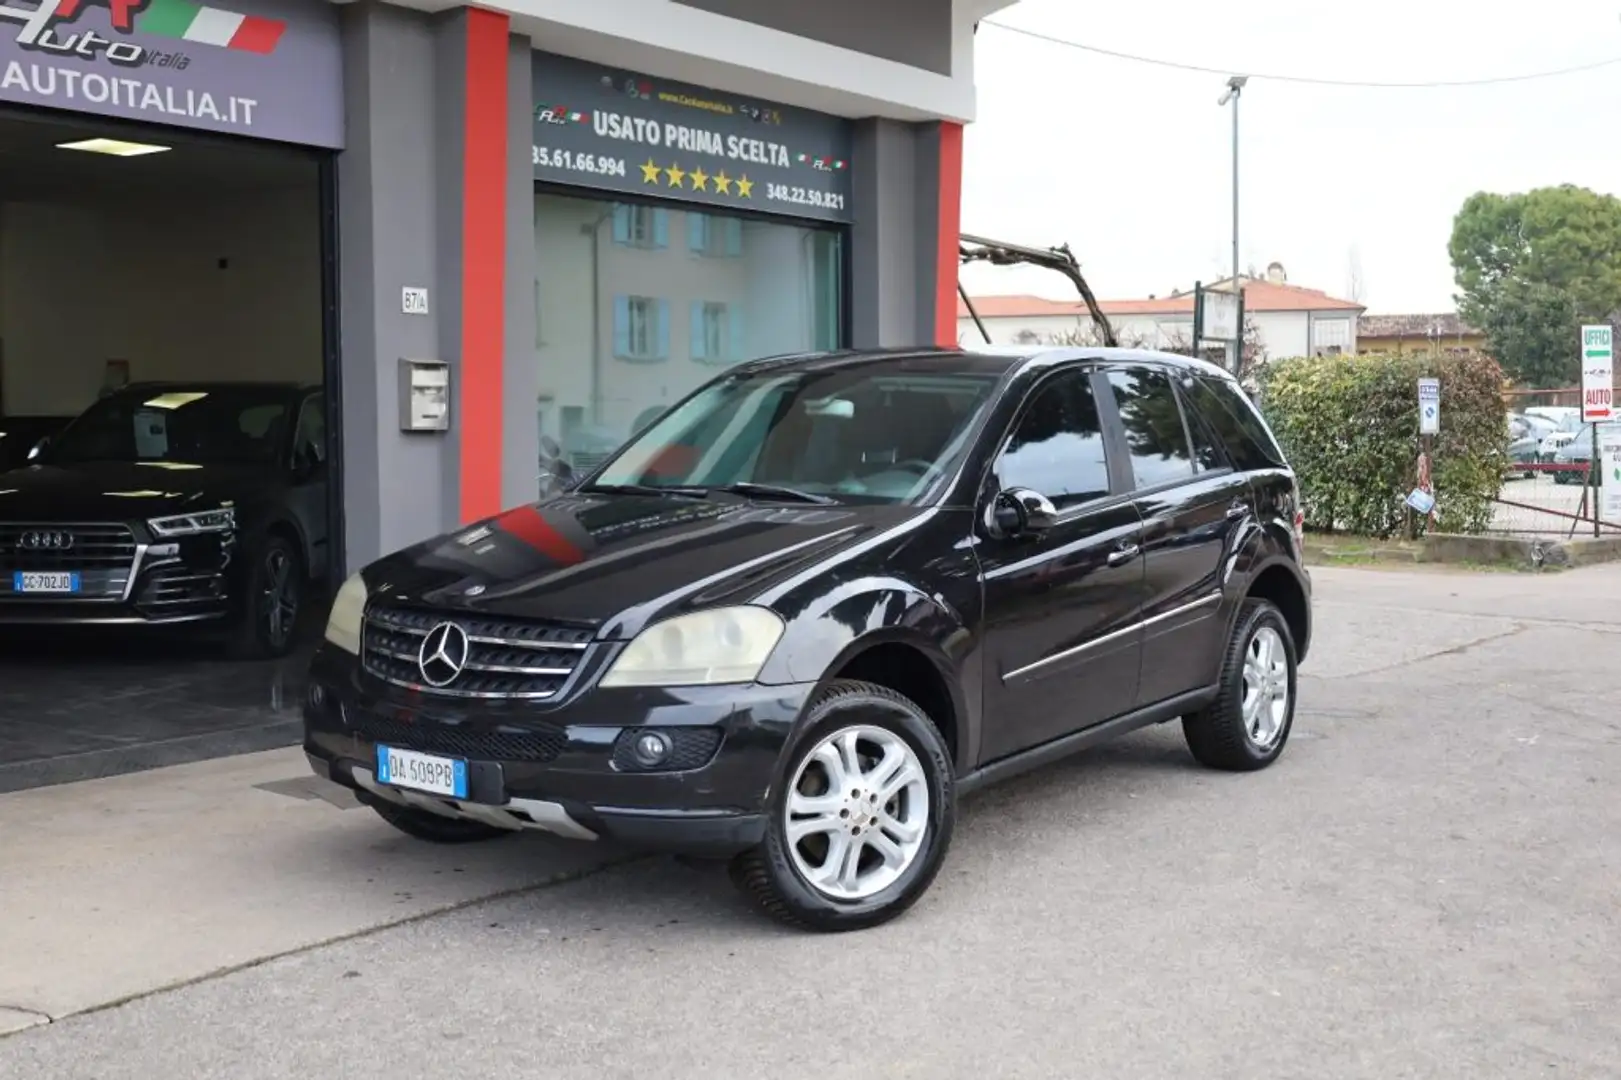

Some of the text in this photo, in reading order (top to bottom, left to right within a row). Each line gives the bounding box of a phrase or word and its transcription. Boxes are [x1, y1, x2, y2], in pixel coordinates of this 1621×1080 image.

[1, 61, 257, 125] AUTOITALIA.IT
[593, 110, 661, 146] USATO
[664, 123, 725, 157] PRIMA
[727, 135, 790, 168] SCELTA
[767, 183, 844, 210] 348.22.50.821
[1584, 329, 1610, 346] UFFICI
[1585, 388, 1611, 405] AUTO
